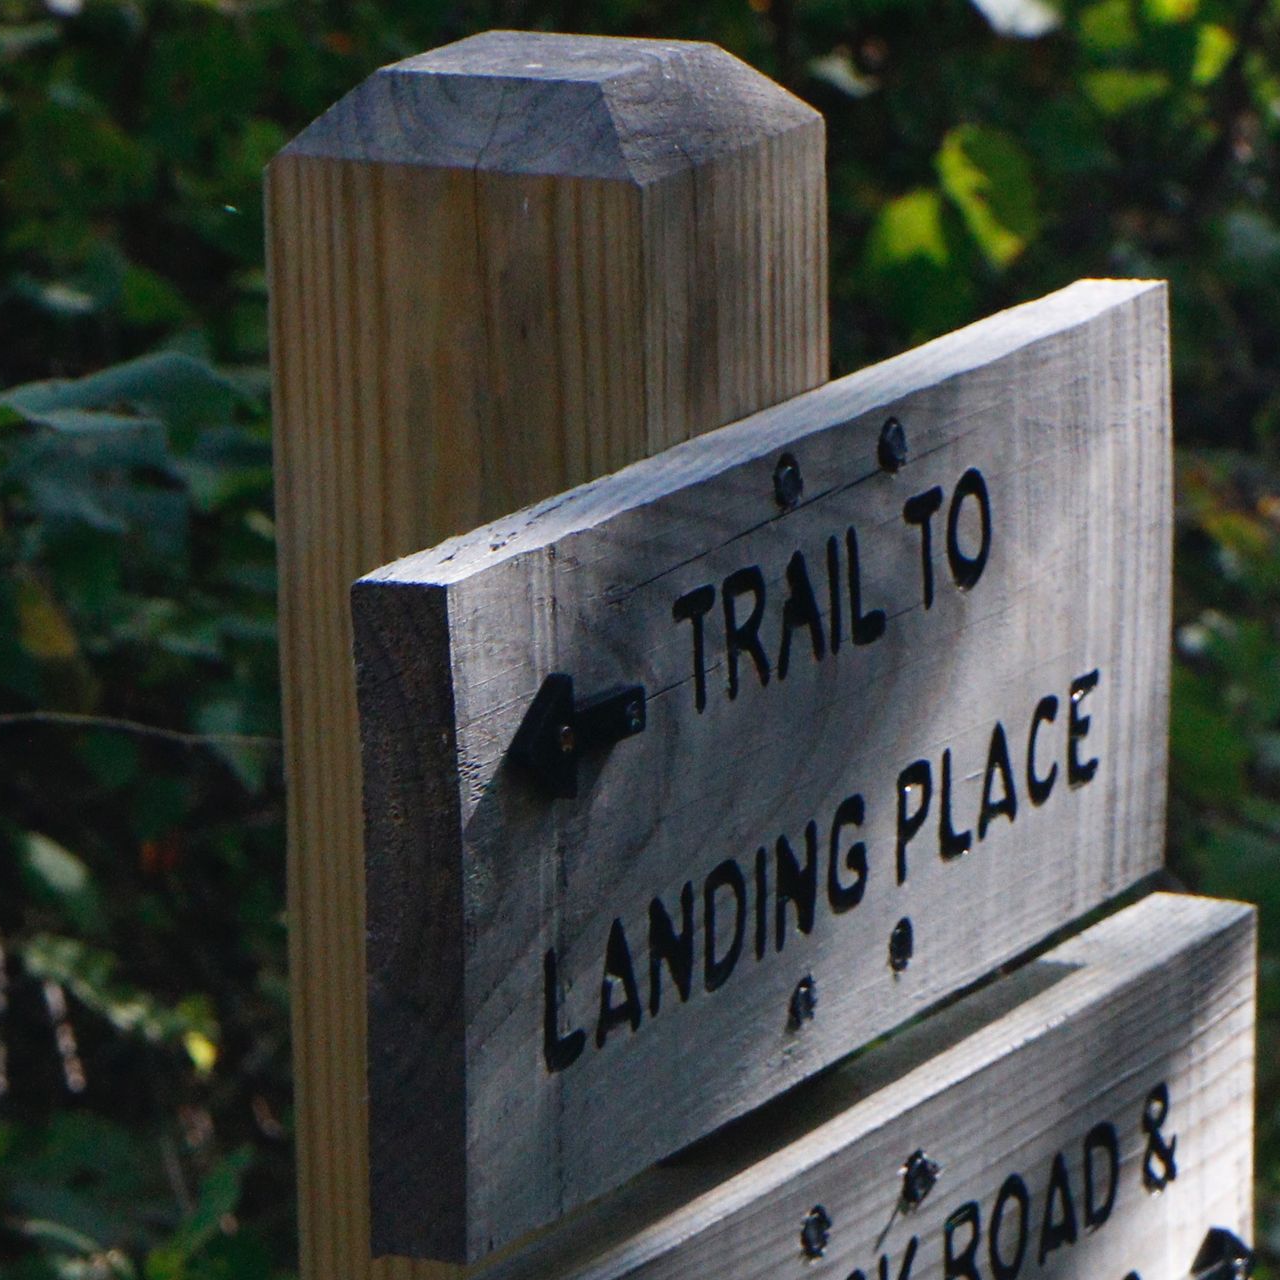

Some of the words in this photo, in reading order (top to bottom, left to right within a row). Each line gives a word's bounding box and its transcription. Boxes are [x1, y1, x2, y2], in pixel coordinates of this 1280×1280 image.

[672, 525, 887, 714] TRAIL
[904, 467, 992, 611] TO
[542, 793, 869, 1073] LANDING
[895, 668, 1100, 885] PLACE
[1141, 1082, 1178, 1193] &
